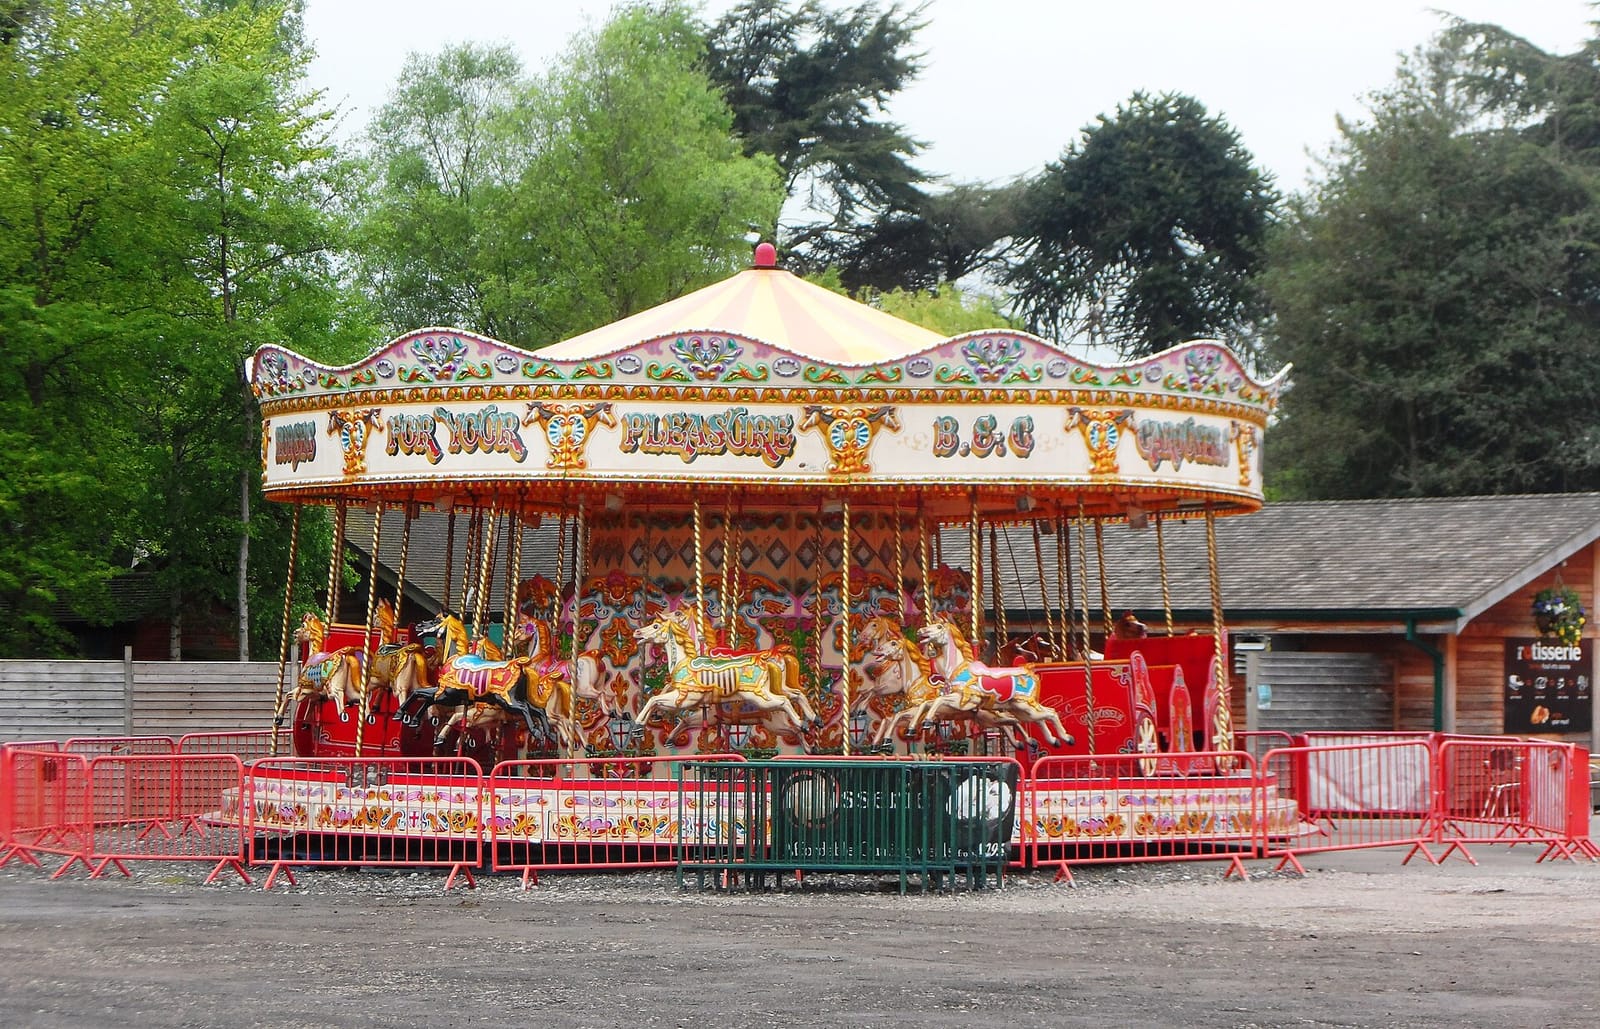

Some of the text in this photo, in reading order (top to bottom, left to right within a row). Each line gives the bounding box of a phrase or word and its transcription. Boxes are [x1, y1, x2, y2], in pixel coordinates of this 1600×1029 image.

[386, 404, 528, 465] FOR YOUR
[619, 407, 797, 468] PLEASURE
[1517, 641, 1582, 661] rotisserie
